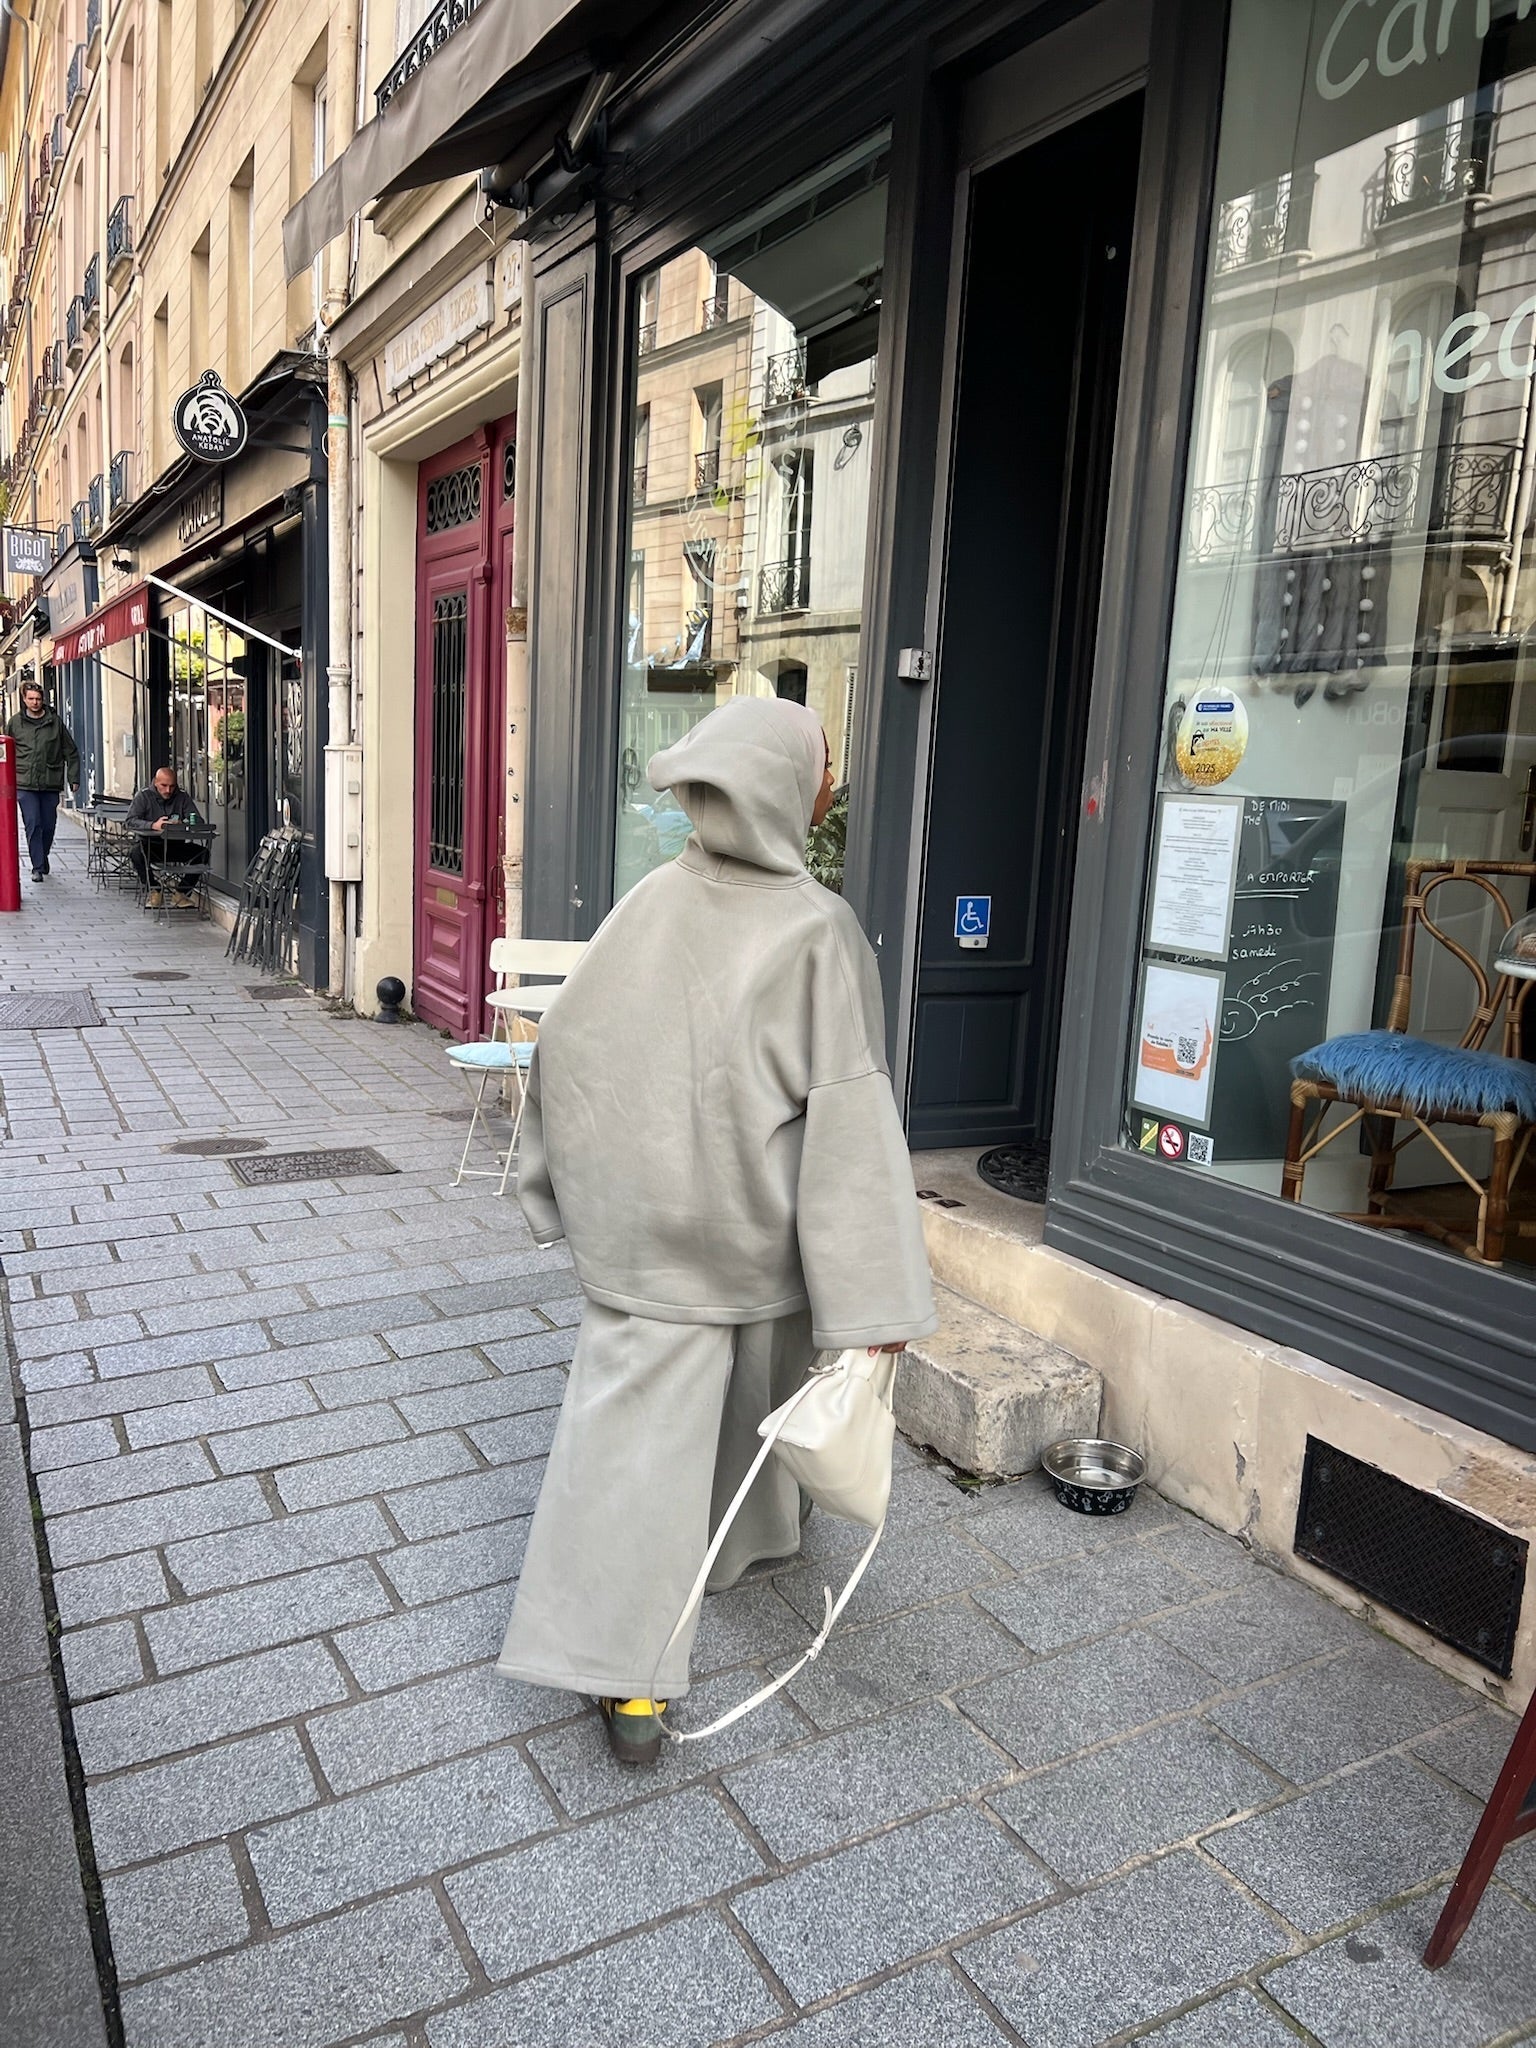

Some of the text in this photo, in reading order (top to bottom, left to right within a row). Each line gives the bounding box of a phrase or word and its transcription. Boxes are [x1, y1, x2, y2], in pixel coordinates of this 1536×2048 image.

[191, 434, 231, 446] ANATOLIE
[10, 534, 47, 560] BIGOT
[1195, 762, 1216, 774] 2025
[1231, 943, 1278, 960] samedi
